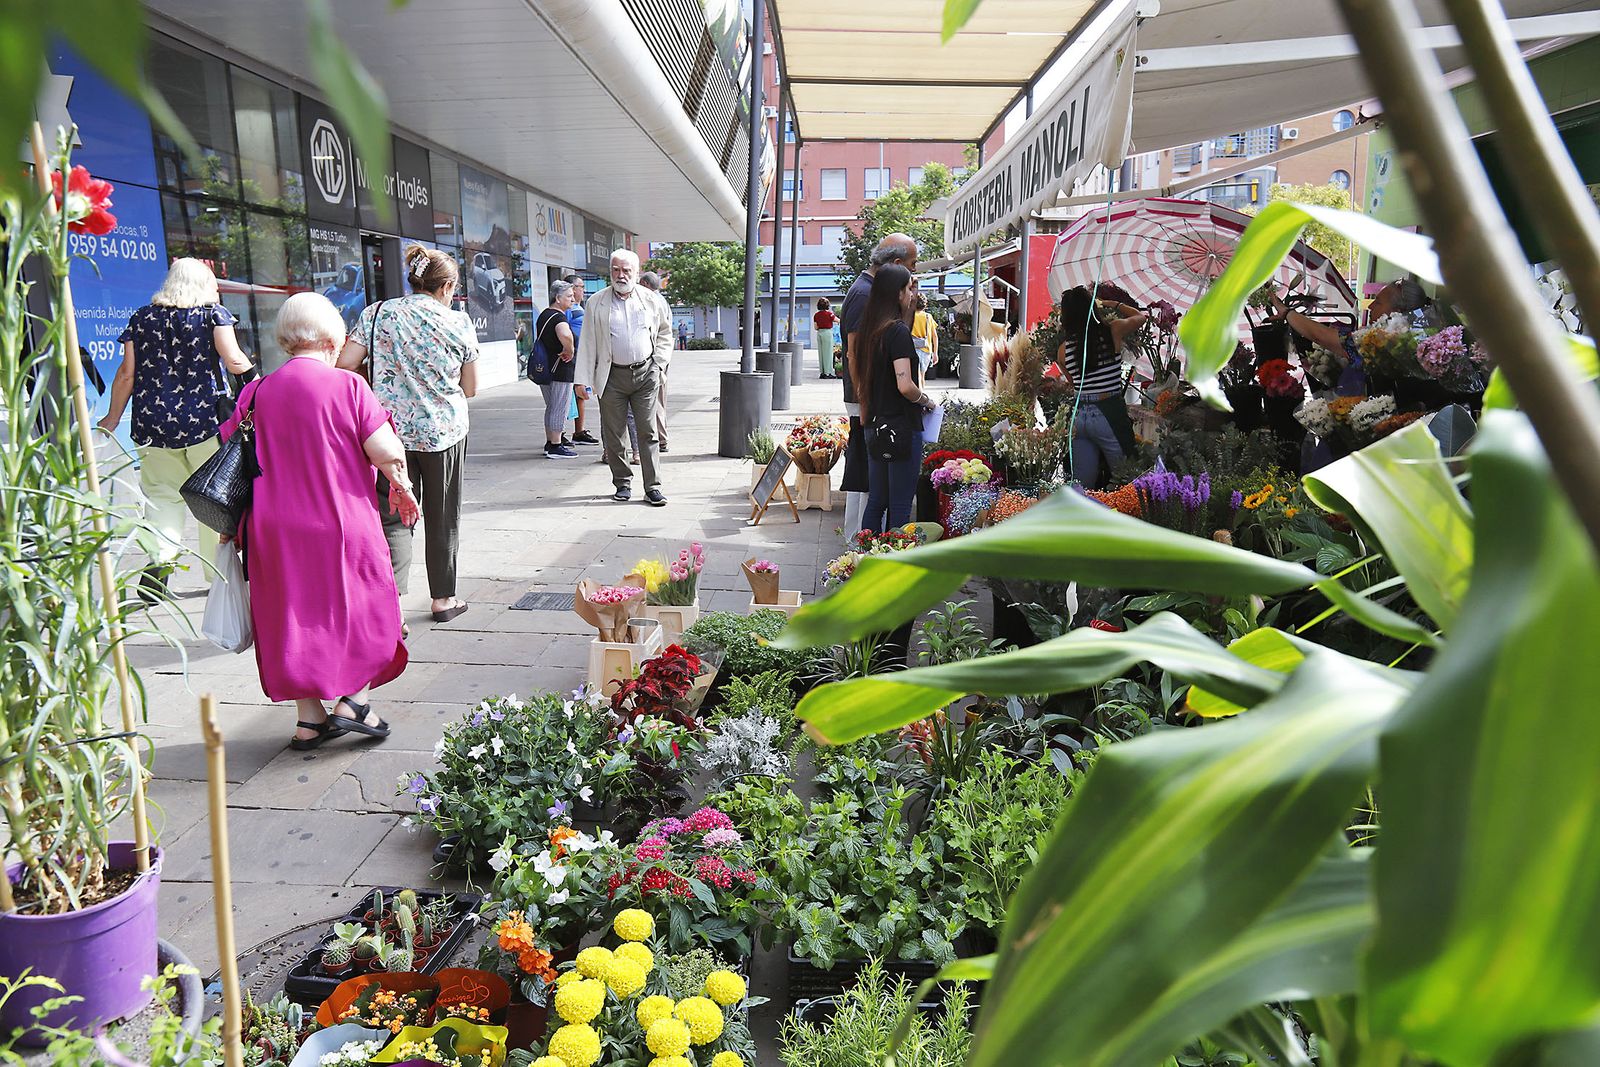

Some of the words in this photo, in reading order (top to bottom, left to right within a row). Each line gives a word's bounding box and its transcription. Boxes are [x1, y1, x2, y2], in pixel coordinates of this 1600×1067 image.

[952, 165, 1013, 243] FLORISTERIA
[1019, 85, 1091, 206] MANOLI
[356, 158, 394, 197] Mor
[396, 171, 428, 209] Inglés
[139, 225, 148, 238] 18
[310, 228, 320, 239] MG
[320, 229, 328, 240] HS
[69, 233, 97, 256] 959
[100, 237, 119, 258] 54
[120, 239, 139, 260] 02
[139, 242, 157, 261] 08
[89, 340, 115, 361] 959
[119, 343, 125, 356] 4
